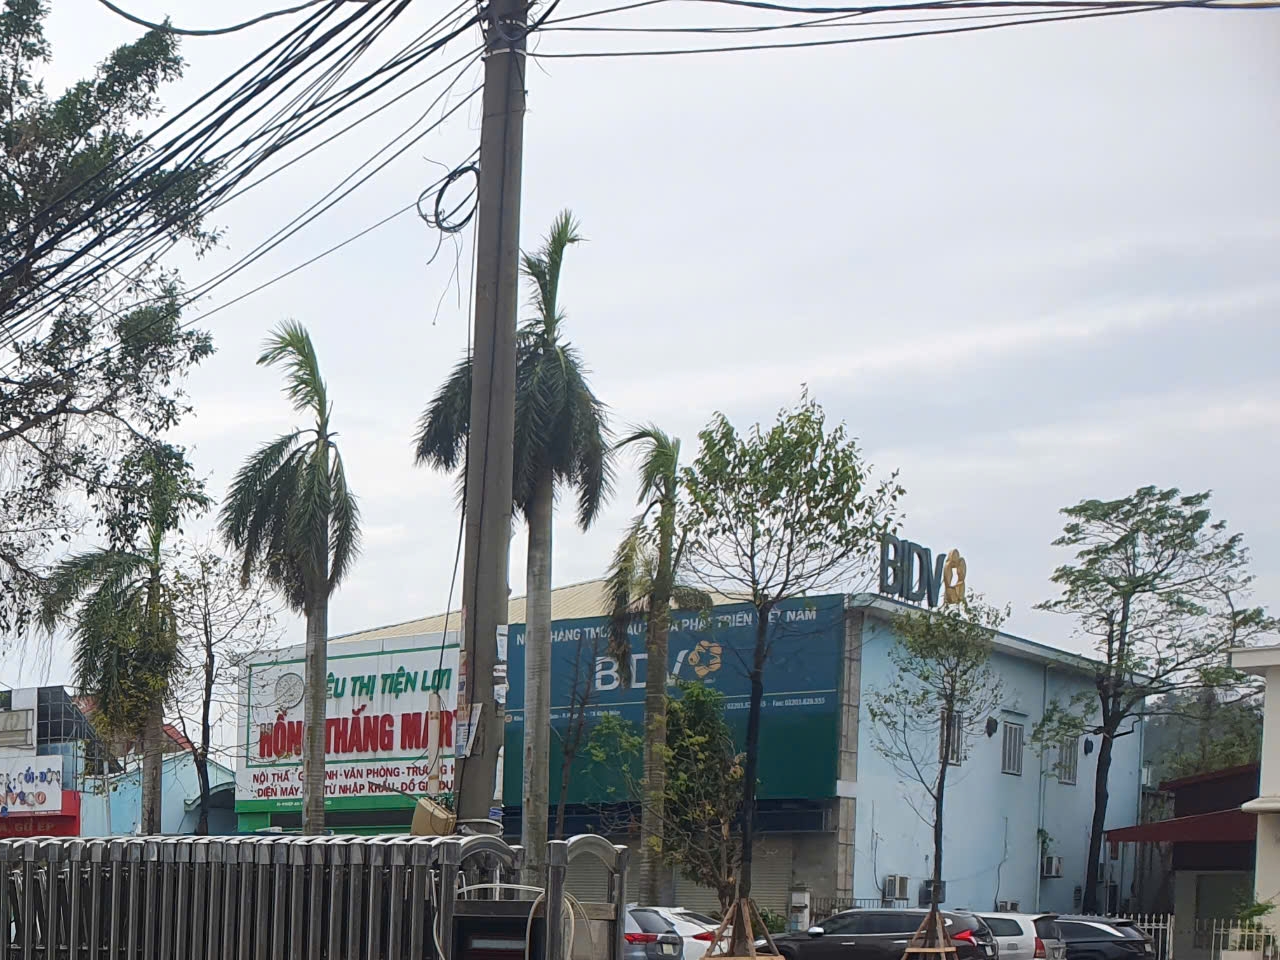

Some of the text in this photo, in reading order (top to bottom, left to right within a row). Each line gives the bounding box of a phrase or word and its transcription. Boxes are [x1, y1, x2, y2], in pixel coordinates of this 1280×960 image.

[880, 533, 946, 608] BIDV
[351, 675, 377, 701] THỊ
[381, 666, 418, 700] TIỆN
[259, 709, 305, 758] HỒN
[326, 704, 394, 754] THẮNG
[280, 784, 300, 797] MÁY
[339, 781, 365, 797] NHẬP
[344, 767, 363, 780] VĂN
[366, 765, 400, 779] PHÒNG
